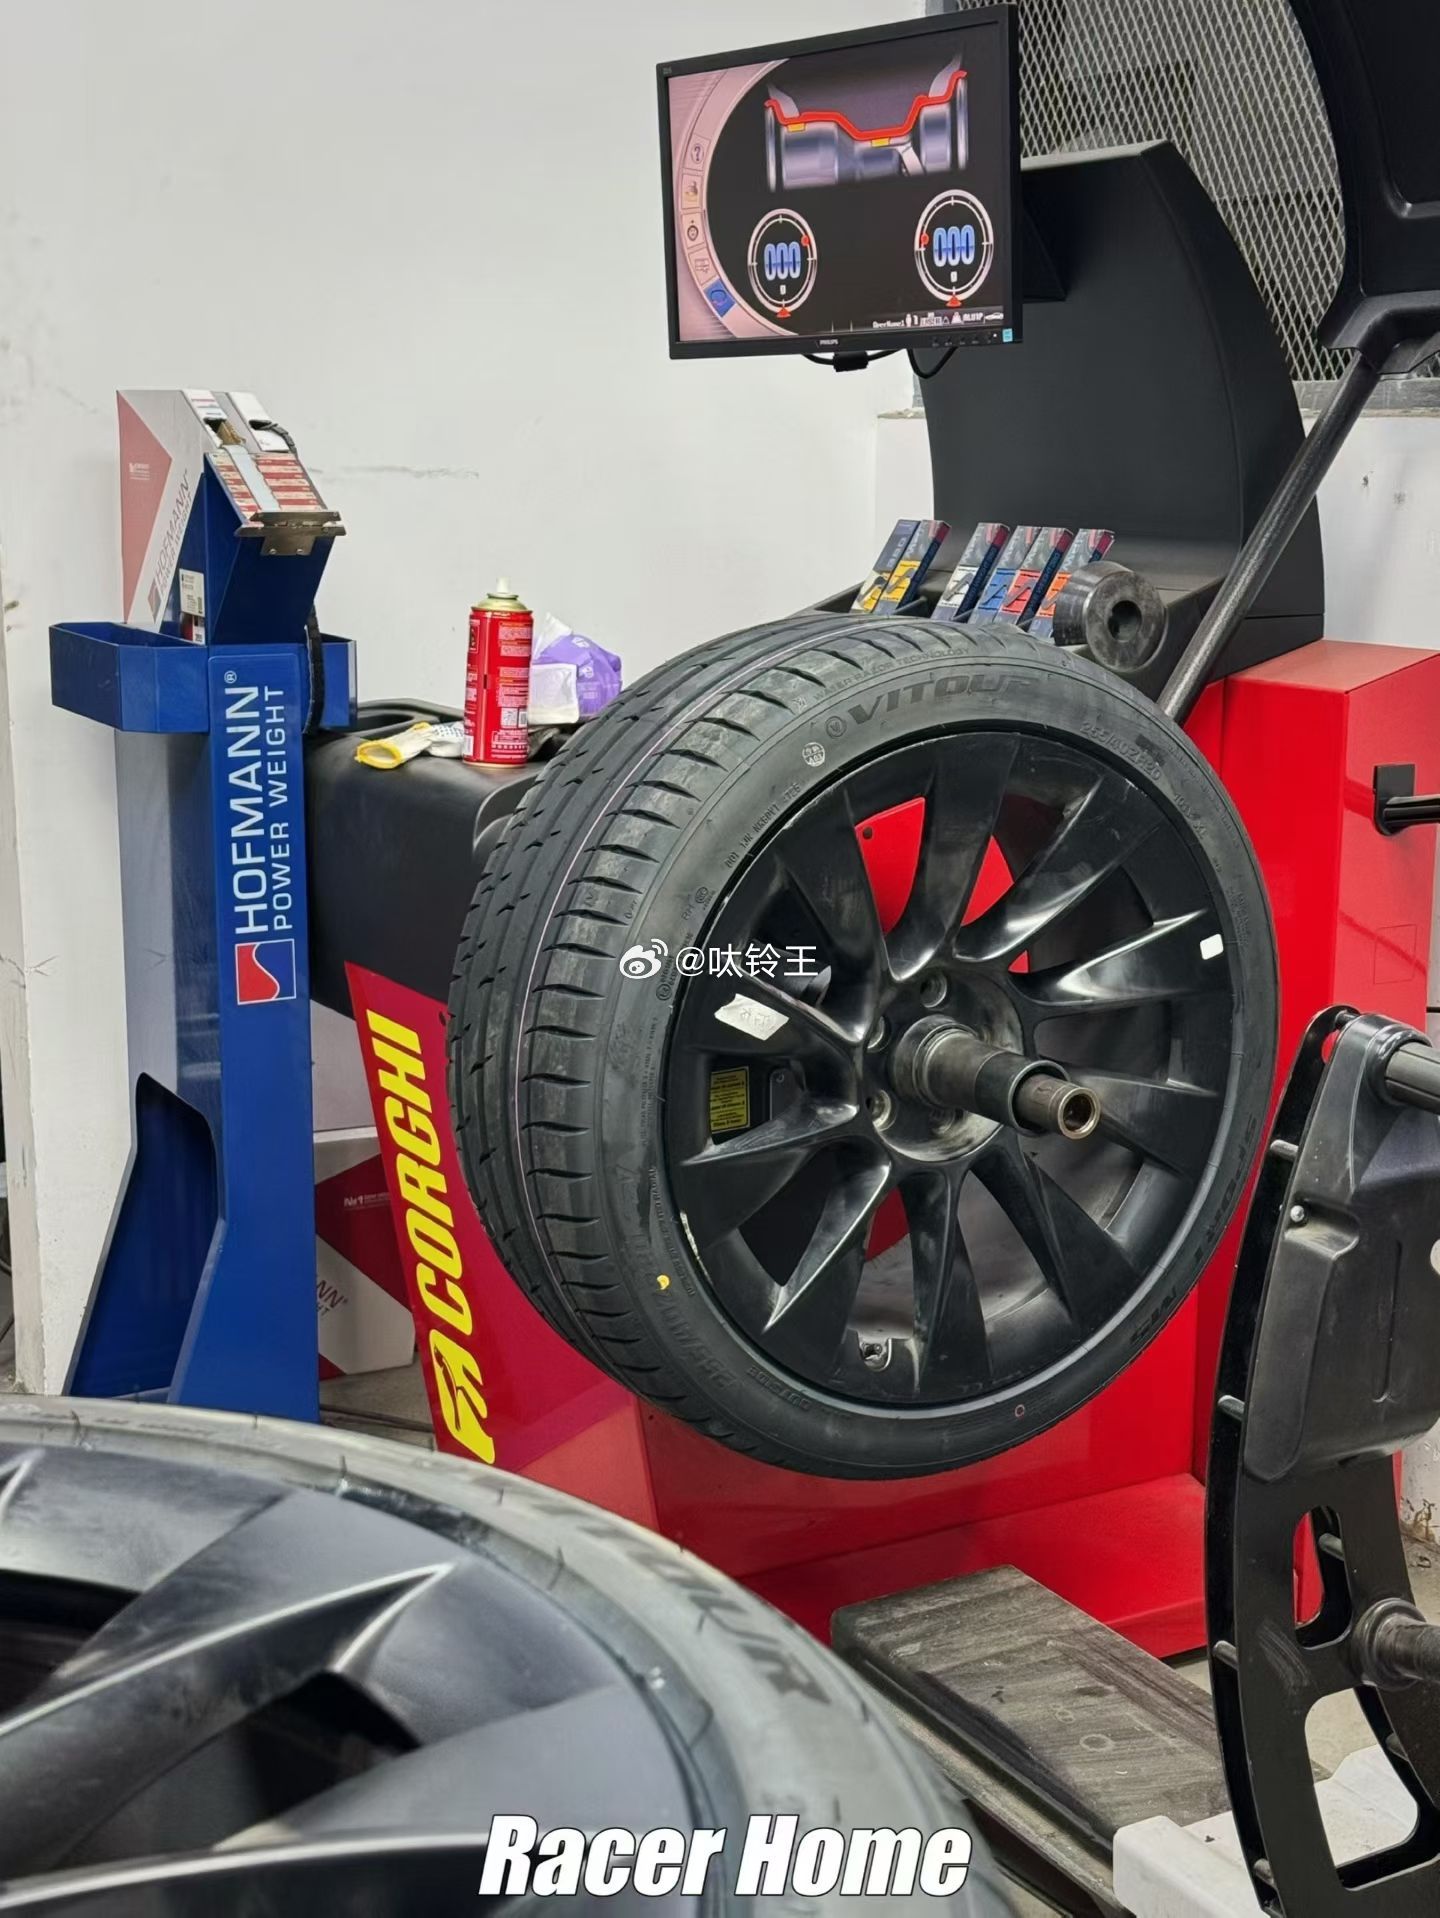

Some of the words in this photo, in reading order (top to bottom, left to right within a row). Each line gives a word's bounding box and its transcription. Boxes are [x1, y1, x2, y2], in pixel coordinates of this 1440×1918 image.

[764, 241, 801, 280] 000
[933, 224, 975, 267] 000
[264, 685, 288, 808] WEIGHT
[271, 822, 293, 931] POWER
[365, 1008, 472, 1336] CORGHI
